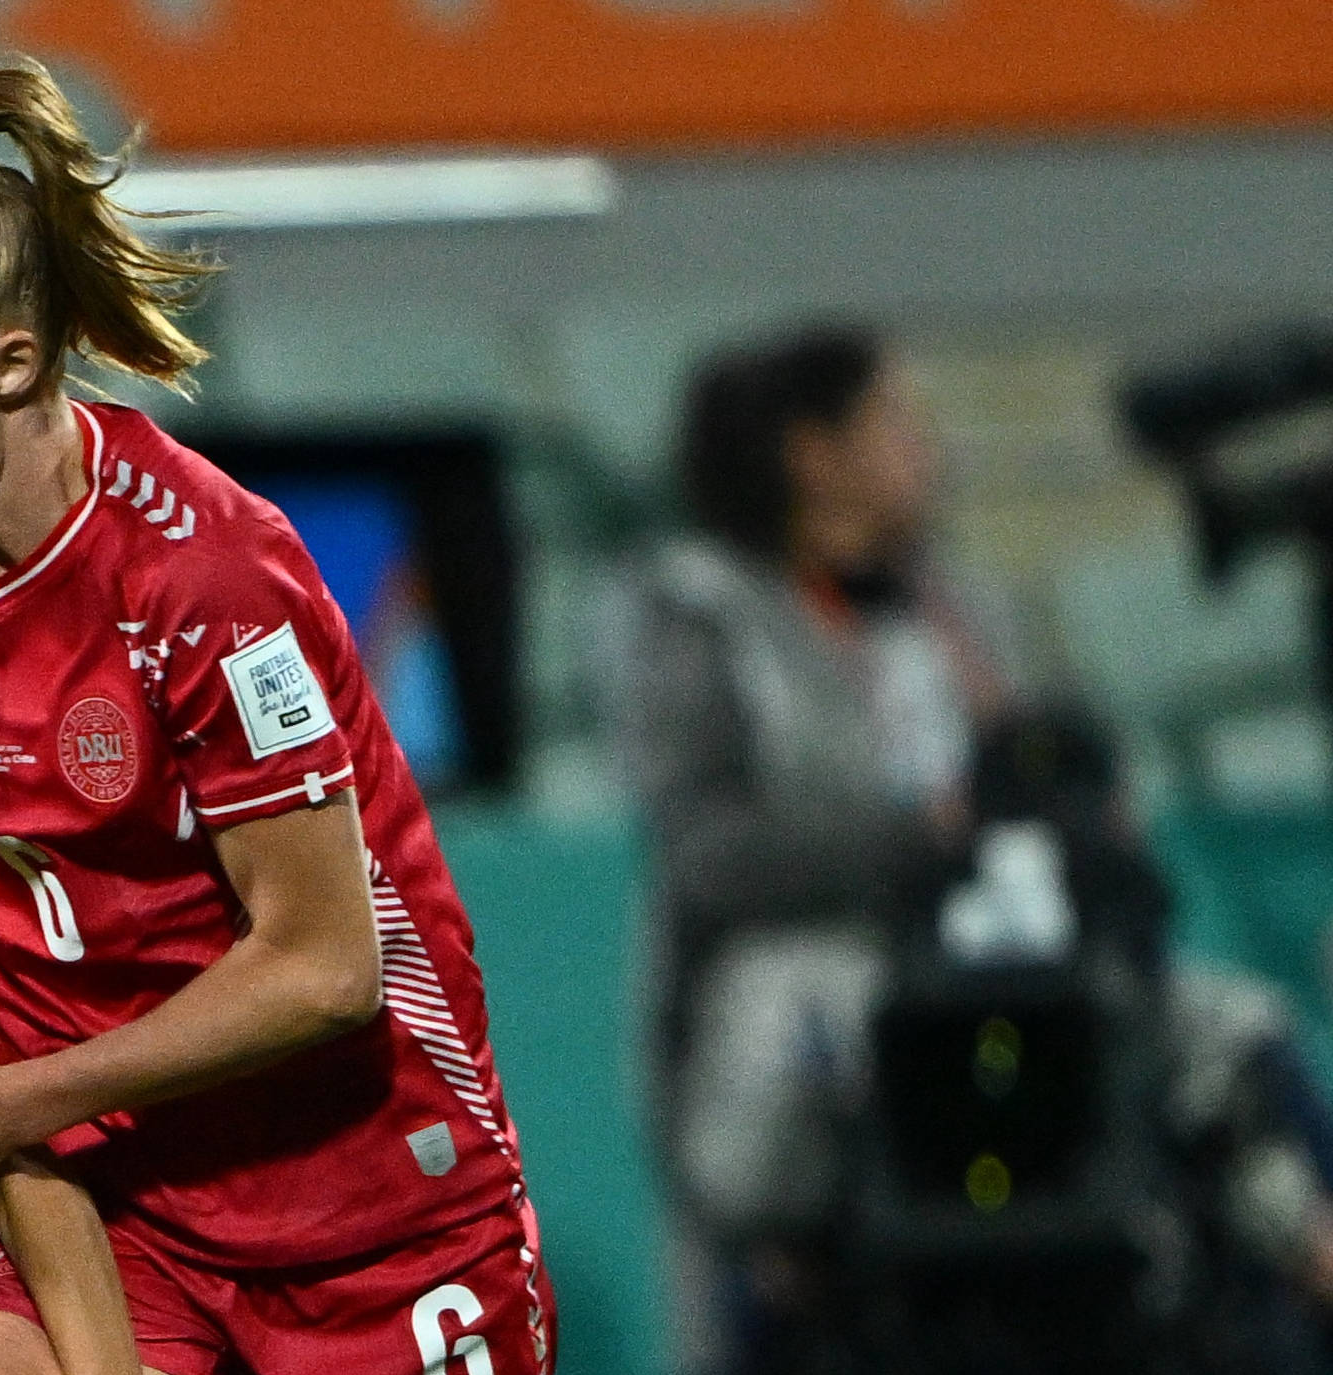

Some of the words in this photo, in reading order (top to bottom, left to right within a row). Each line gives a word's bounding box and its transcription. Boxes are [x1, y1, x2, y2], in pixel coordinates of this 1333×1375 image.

[248, 648, 296, 680] FOOTBALL
[254, 662, 303, 698] UNITES
[76, 733, 124, 763] DBU
